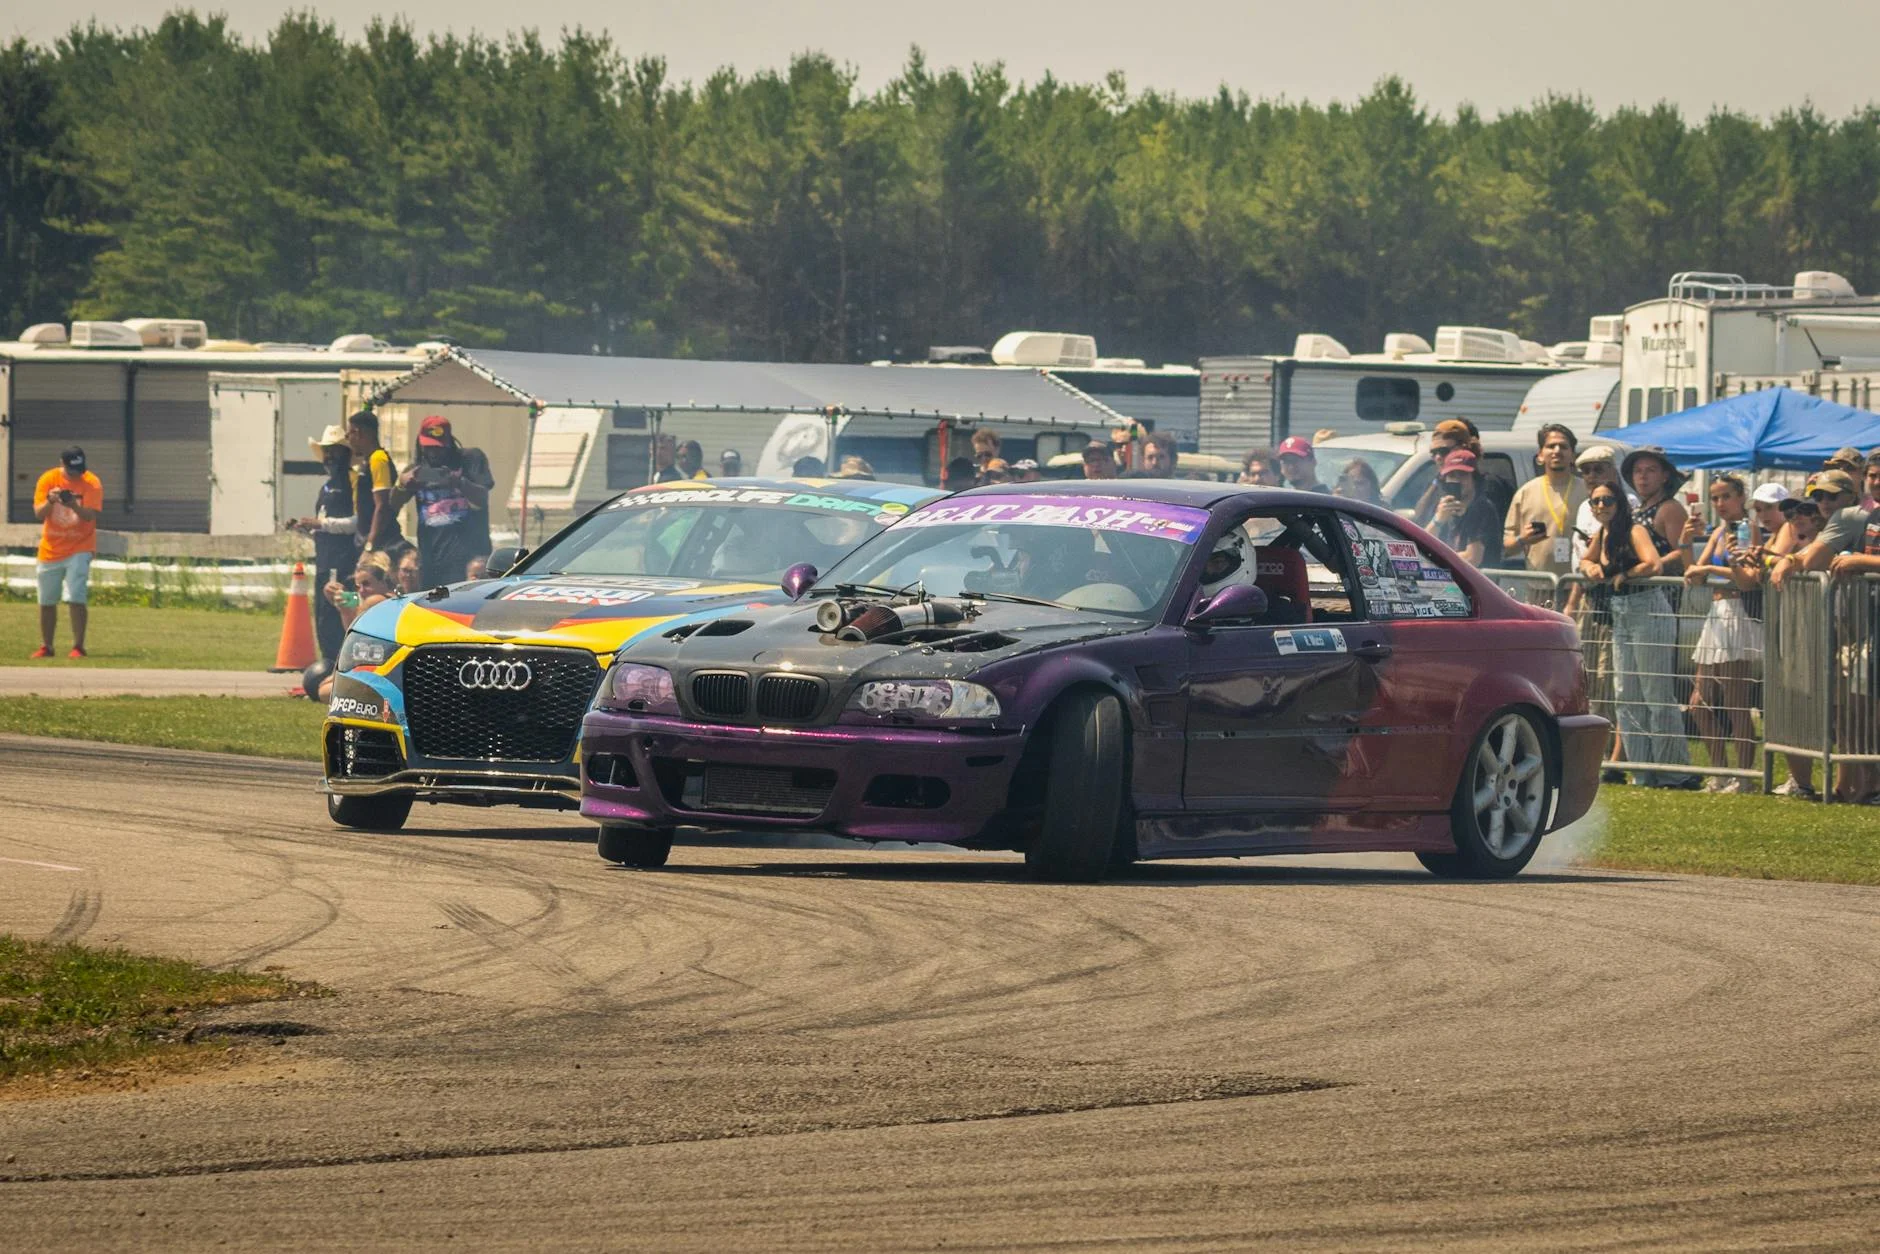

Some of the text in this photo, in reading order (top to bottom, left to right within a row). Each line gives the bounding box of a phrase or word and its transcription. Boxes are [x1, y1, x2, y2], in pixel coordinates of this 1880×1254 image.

[650, 489, 798, 506] GRIDLIFE
[784, 493, 884, 516] DRIFT
[899, 504, 1021, 528] BEAT
[1010, 504, 1152, 530] BASH
[1387, 542, 1418, 557] SIMPSON
[336, 698, 357, 712] FCP
[356, 703, 378, 716] EURO
